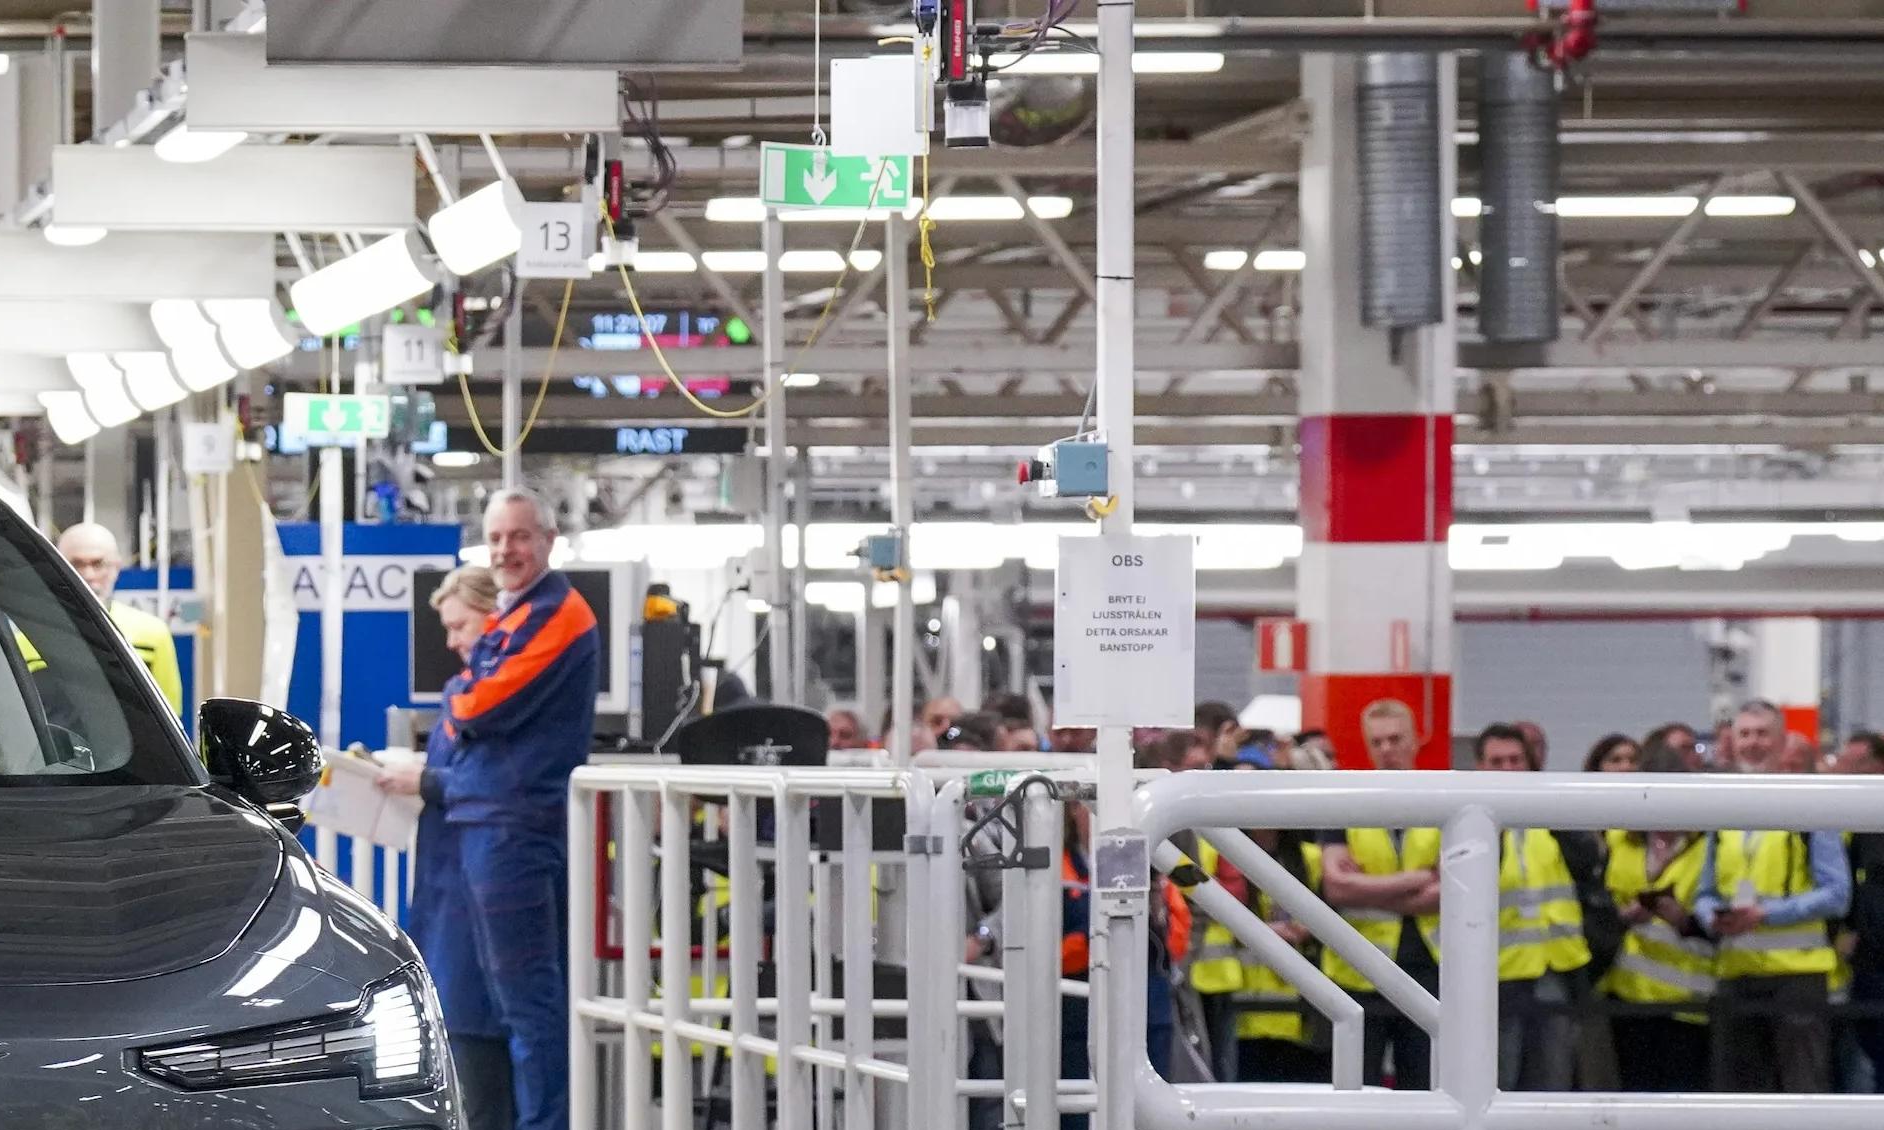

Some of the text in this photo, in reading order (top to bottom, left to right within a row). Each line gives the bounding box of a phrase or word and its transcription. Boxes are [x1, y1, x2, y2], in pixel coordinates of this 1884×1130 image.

[540, 221, 571, 251] 13
[617, 428, 688, 453] RAST
[1111, 555, 1144, 567] OBS
[1108, 595, 1146, 604] BRYT EJ
[1092, 609, 1162, 619] LJUSSTRÅLEN
[1085, 628, 1169, 637] DETTA ORSAKAR
[1099, 643, 1154, 652] BANSTOPP
